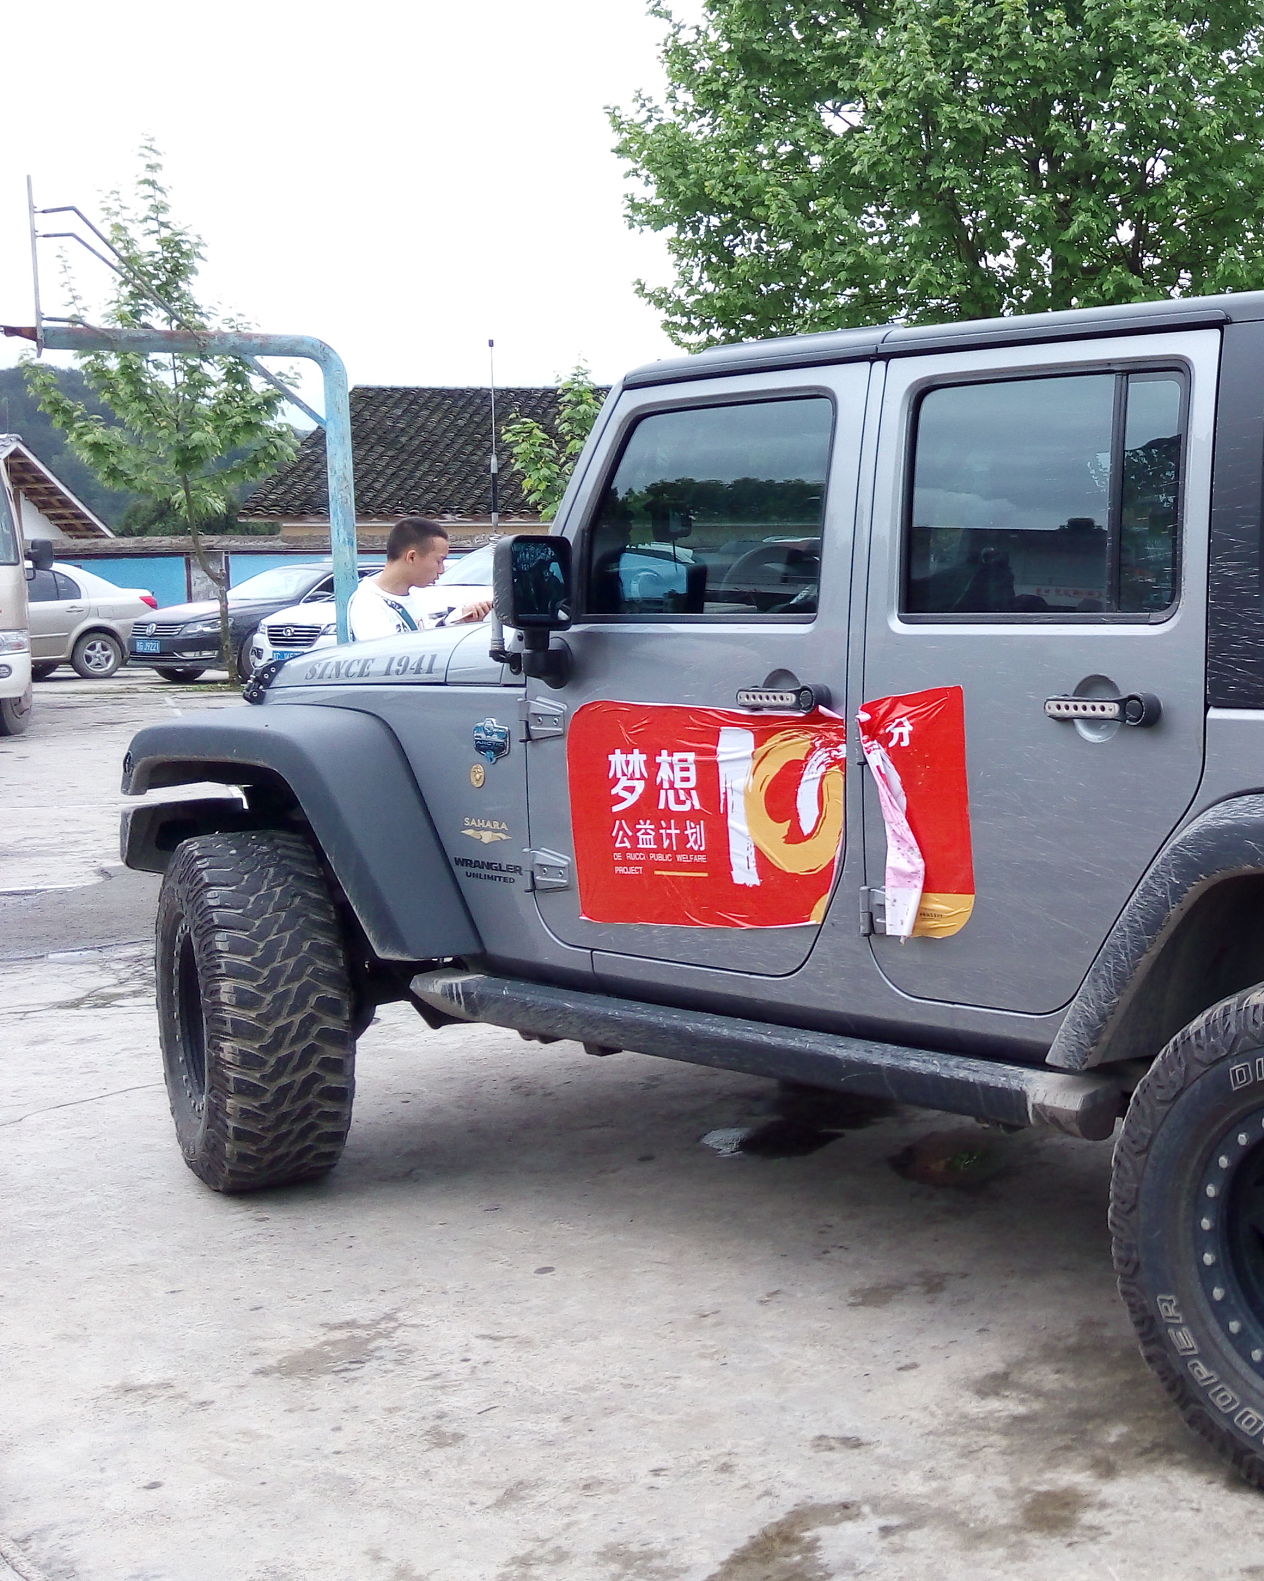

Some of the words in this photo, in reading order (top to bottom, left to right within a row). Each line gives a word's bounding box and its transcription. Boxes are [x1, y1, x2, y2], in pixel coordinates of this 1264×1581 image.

[304, 658, 376, 680] SINCE
[383, 654, 438, 676] 1941
[475, 740, 505, 748] ARCTIC
[608, 748, 701, 813] 梦想
[463, 817, 509, 831] SAHARA
[611, 819, 706, 851] 公益计划
[613, 852, 623, 861] DE
[649, 853, 673, 862] PUBLIC
[676, 854, 708, 863] WELFARE
[454, 857, 524, 876] WRANGLER
[614, 866, 643, 875] PROJECT
[465, 871, 516, 884] UNLIMITED
